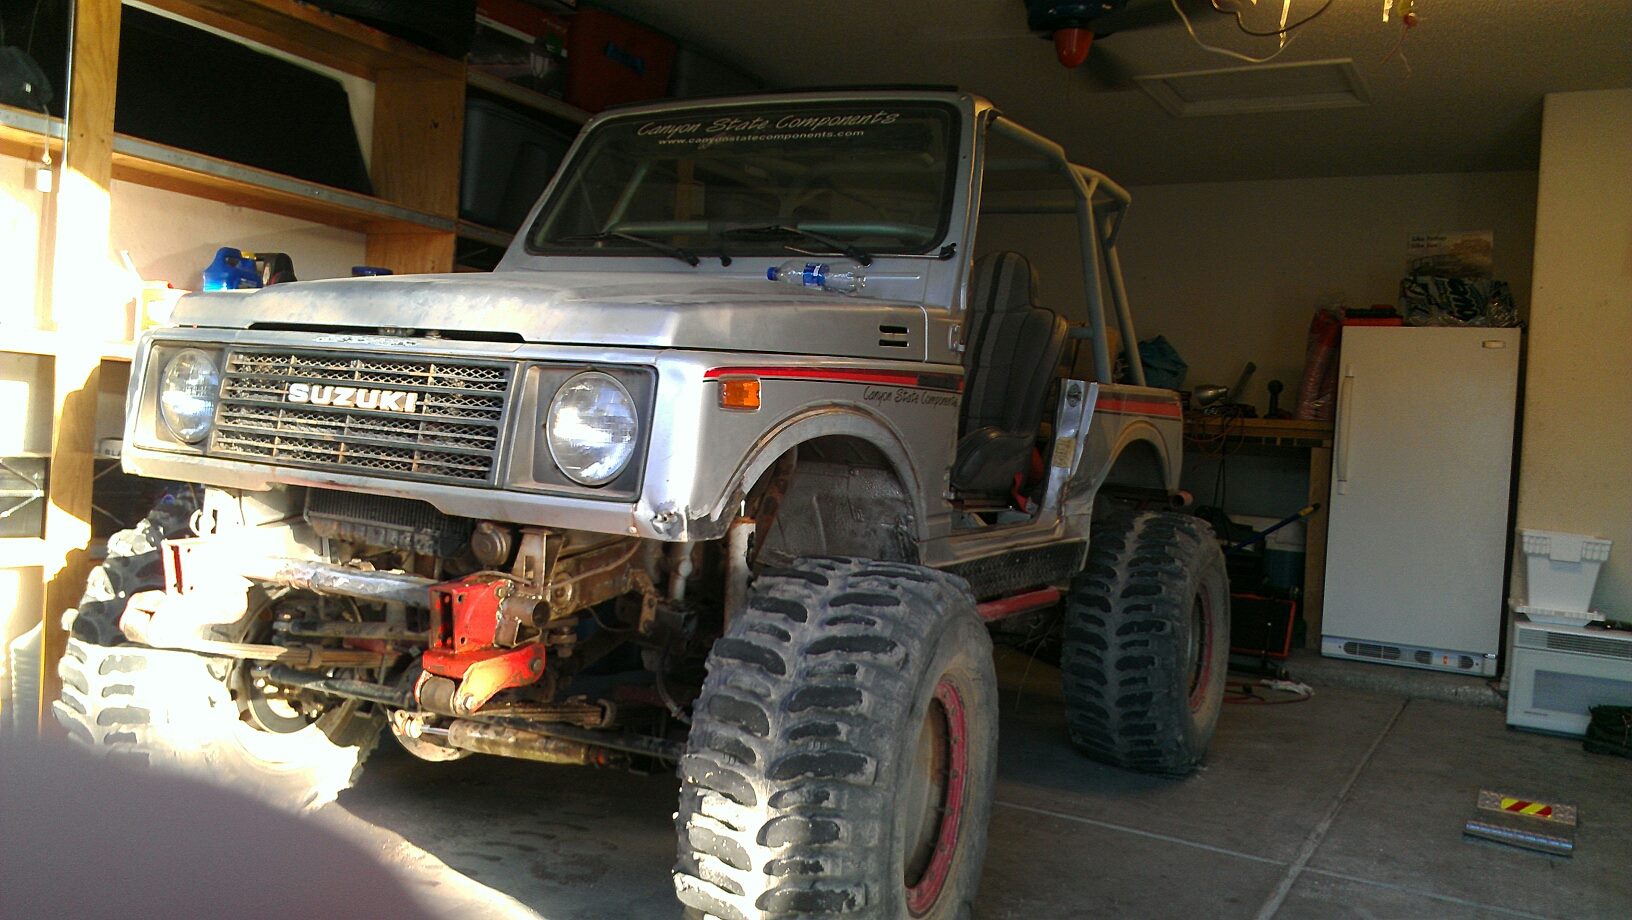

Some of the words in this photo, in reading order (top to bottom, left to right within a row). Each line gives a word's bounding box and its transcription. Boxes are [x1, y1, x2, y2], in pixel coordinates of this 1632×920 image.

[637, 121, 701, 139] Canyon
[706, 117, 769, 133] State
[776, 110, 899, 130] Components
[658, 130, 865, 145] www.canyonstatecomponents.com
[288, 382, 419, 413] SUZUKI
